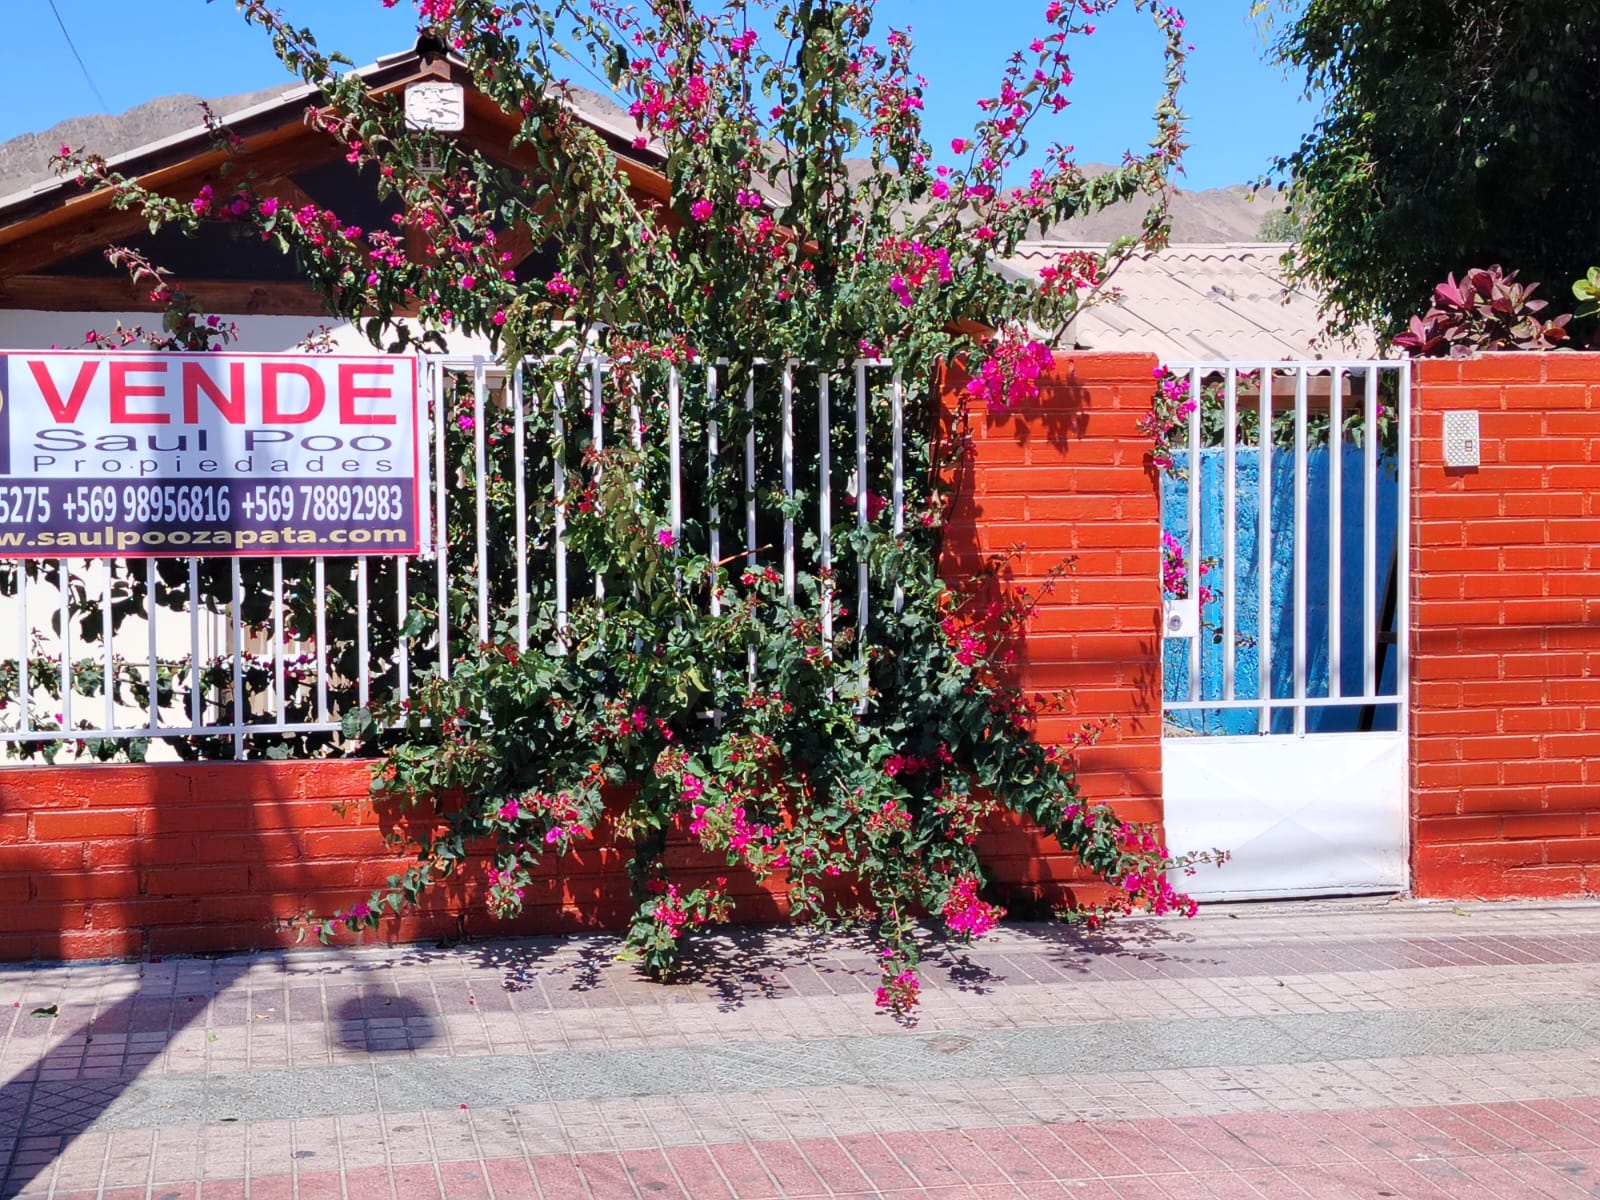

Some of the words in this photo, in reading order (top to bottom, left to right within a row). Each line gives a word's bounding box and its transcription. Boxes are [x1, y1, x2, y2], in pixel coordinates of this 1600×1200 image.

[27, 361, 397, 424] VENDE
[33, 429, 207, 452] Saul
[245, 429, 393, 452] Poo
[33, 455, 393, 477] Propiedades
[62, 485, 117, 523] +569
[123, 485, 230, 523] 98956816
[241, 485, 294, 522] +569
[300, 485, 403, 521] 78892983
